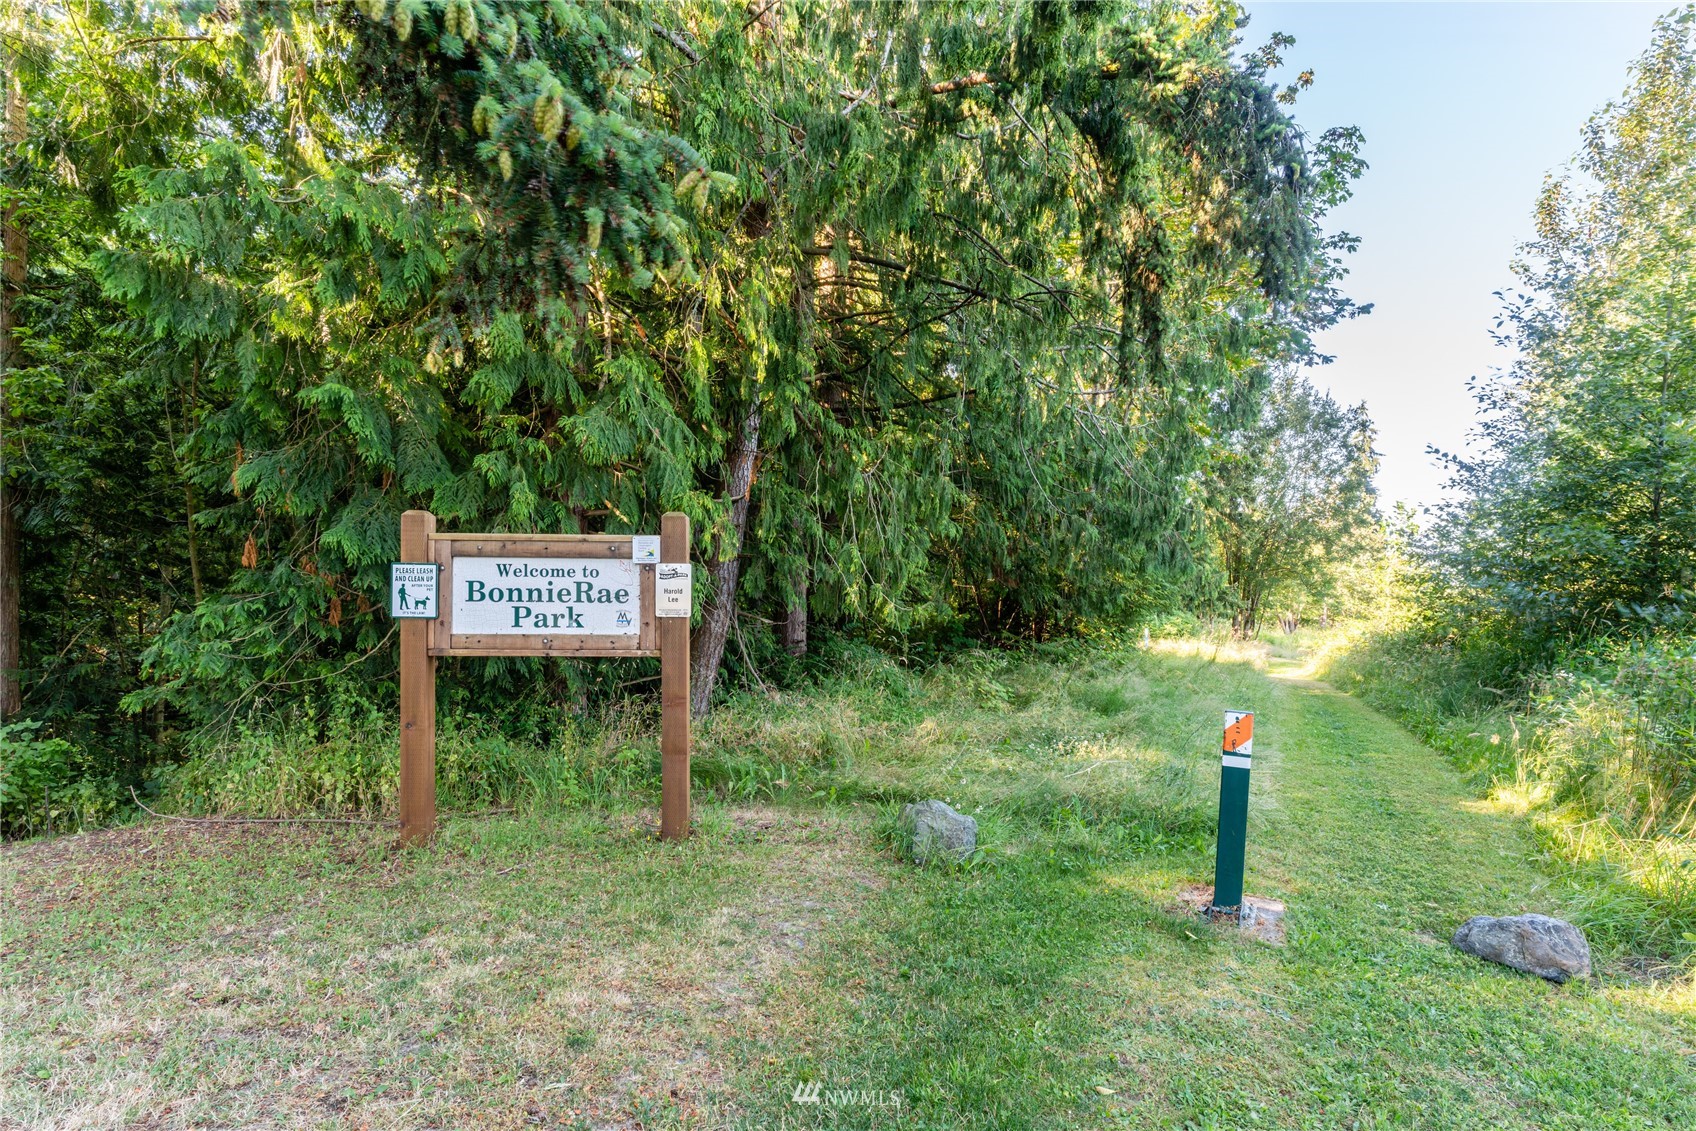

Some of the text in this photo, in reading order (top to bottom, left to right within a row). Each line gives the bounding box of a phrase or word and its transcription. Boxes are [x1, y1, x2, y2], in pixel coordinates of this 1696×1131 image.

[496, 563, 600, 578] Welcome to
[465, 580, 630, 604] BonnieRae
[511, 605, 585, 629] Park
